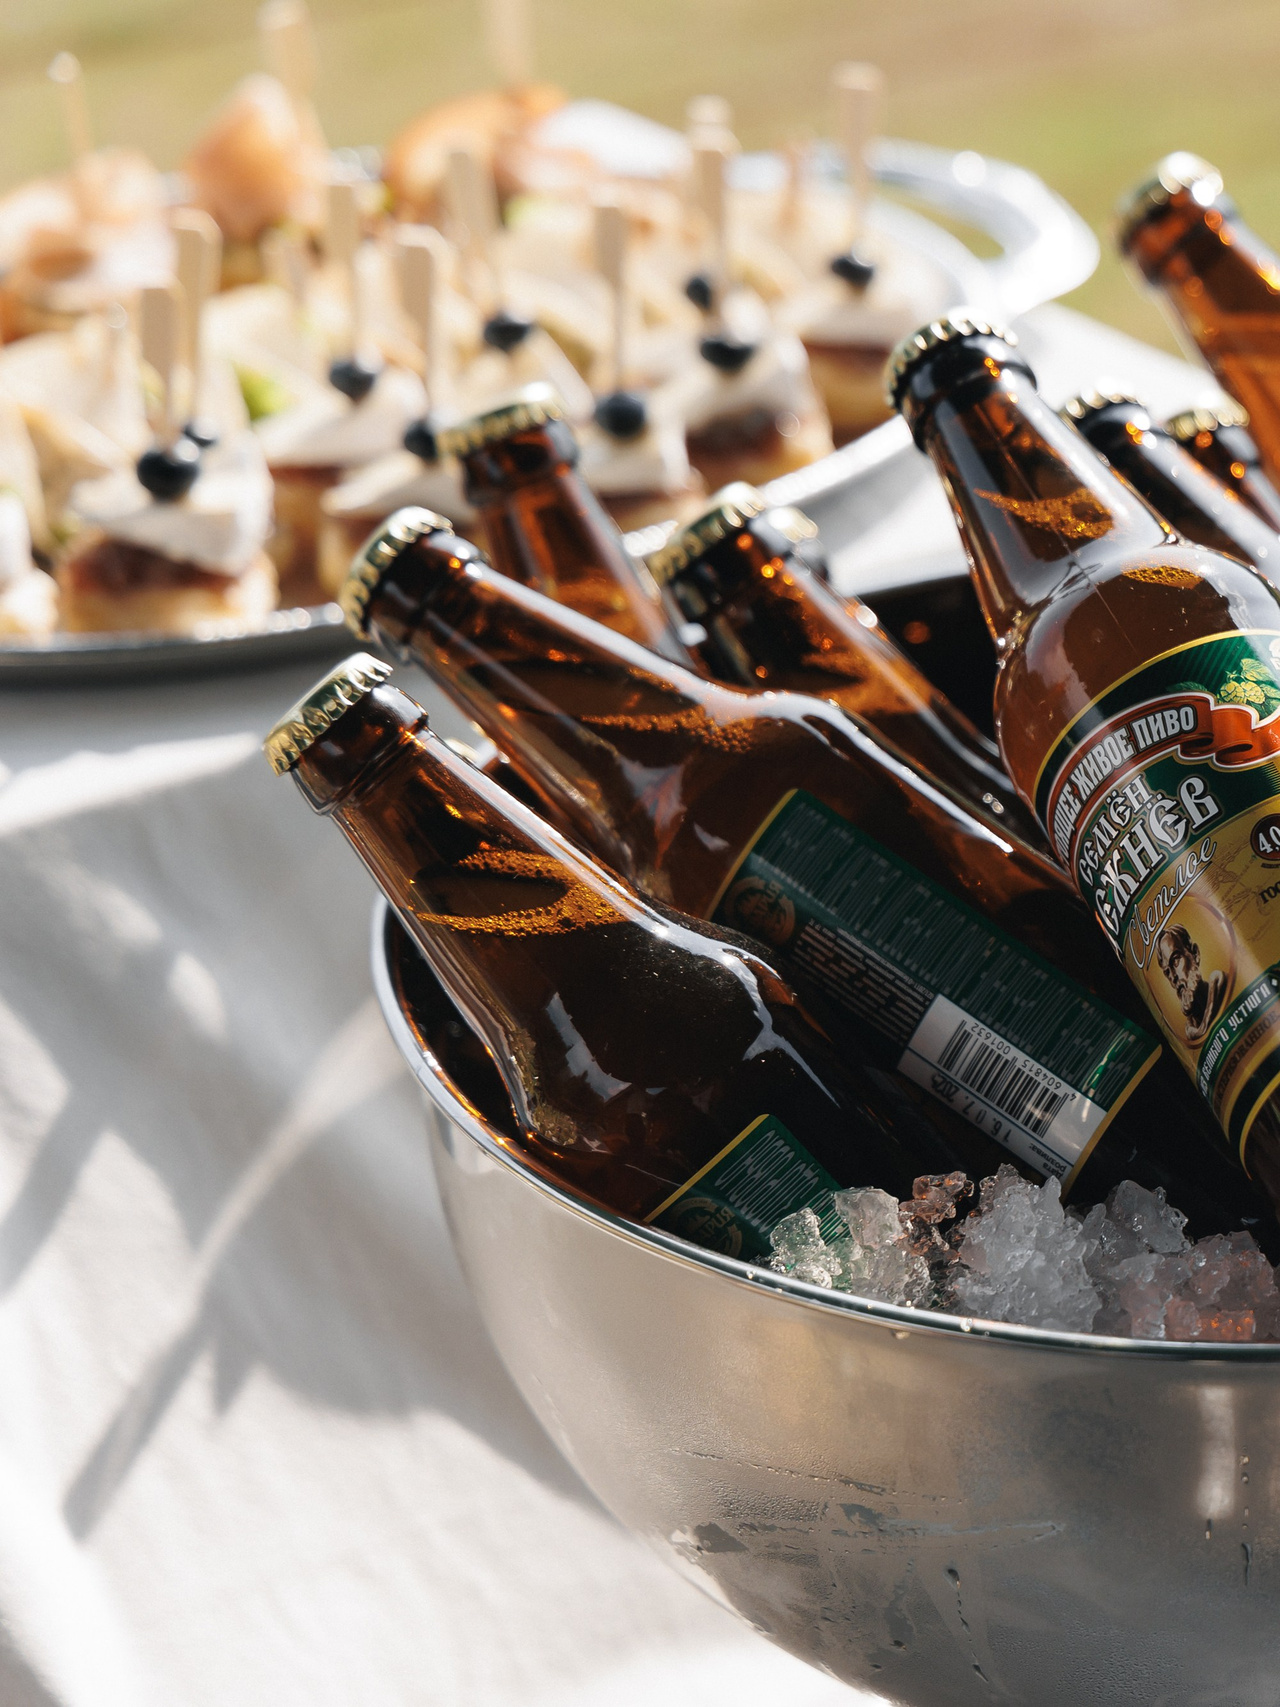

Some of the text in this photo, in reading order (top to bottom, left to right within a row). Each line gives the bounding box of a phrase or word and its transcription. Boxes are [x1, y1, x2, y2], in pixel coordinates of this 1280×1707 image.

[1071, 727, 1135, 801] ЖИВОЕ
[1132, 706, 1195, 750] ПИВО
[1079, 773, 1153, 887] СЕМЁН
[1095, 777, 1220, 960] ЕЖНЁВ
[1128, 837, 1218, 969] Светлое
[970, 1022, 1078, 1102] 4 604815 001632
[1205, 1028, 1231, 1082] ВЕЛИКОГО
[1228, 983, 1271, 1031] УСТЮГА
[1029, 1142, 1067, 1172] розлива:
[1043, 1162, 1065, 1181] Дата
